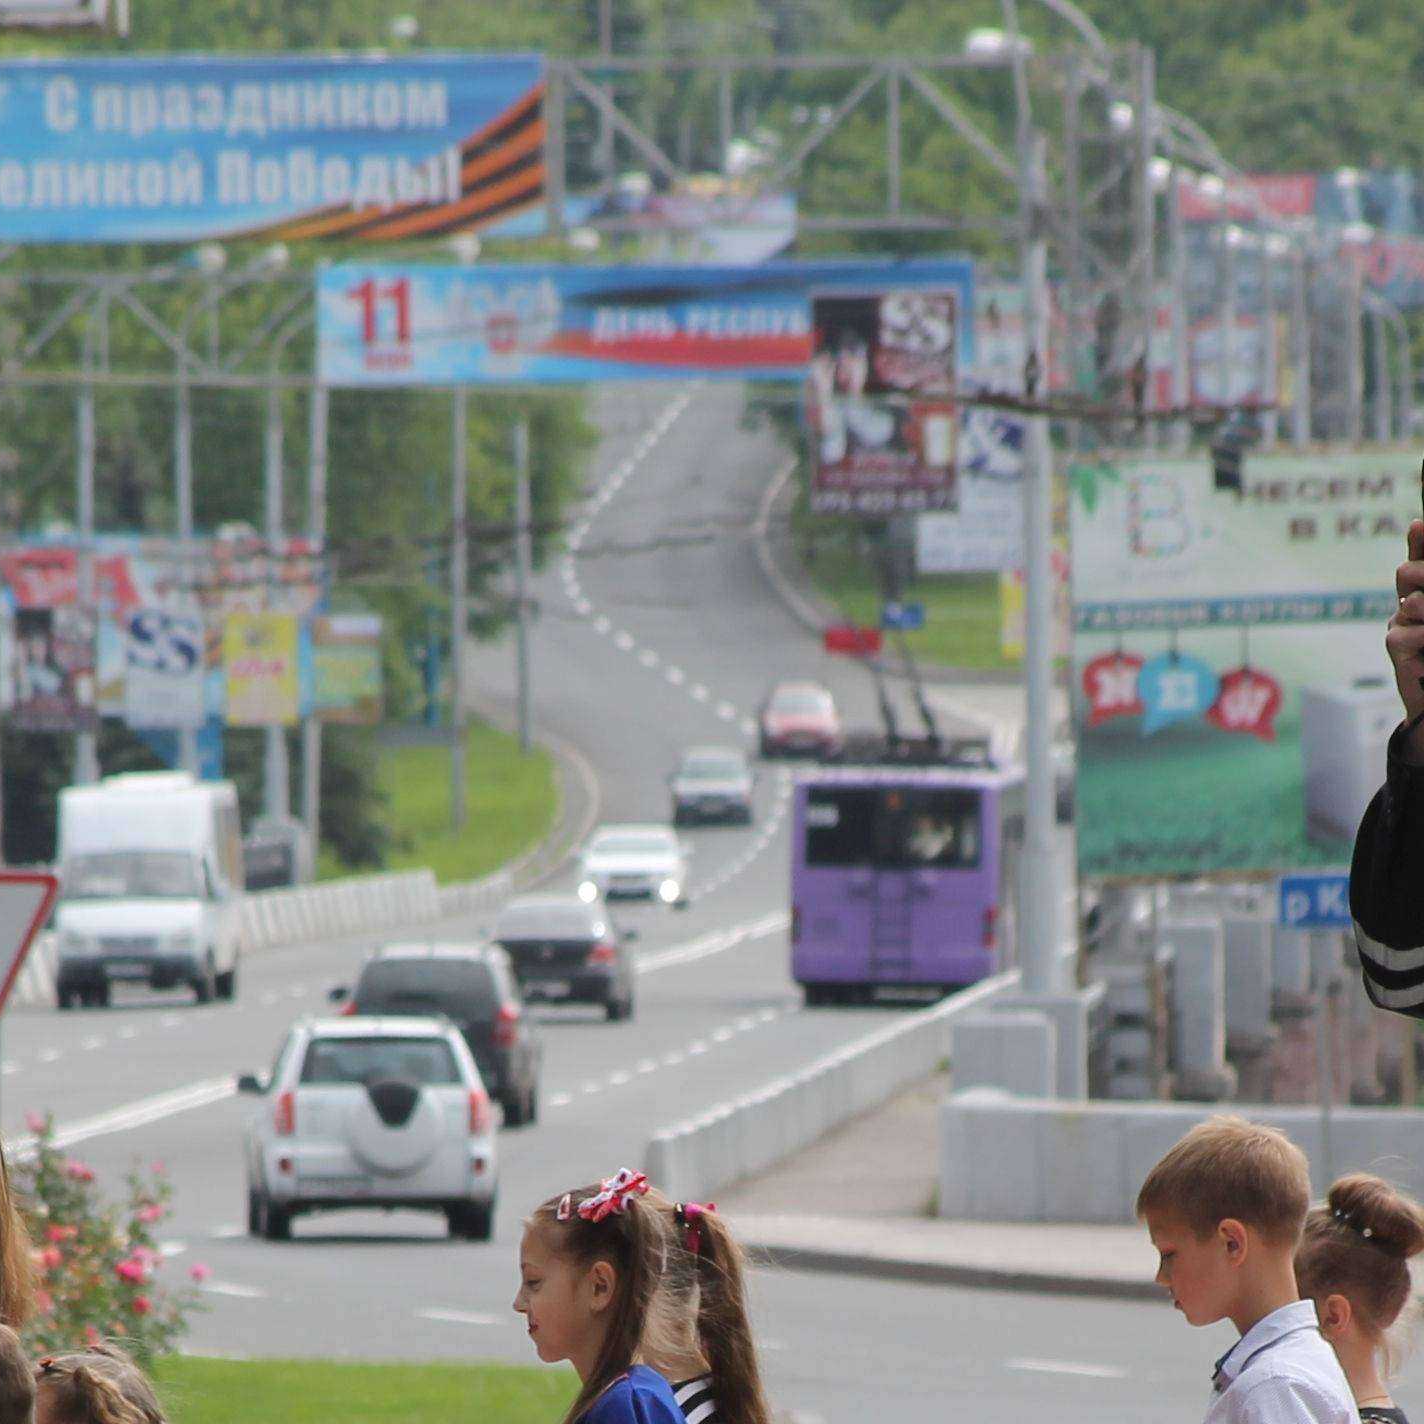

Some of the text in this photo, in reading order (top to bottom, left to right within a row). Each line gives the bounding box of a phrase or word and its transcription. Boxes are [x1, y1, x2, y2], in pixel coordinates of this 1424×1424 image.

[46, 75, 448, 137] С праздником
[216, 146, 462, 212] Победы!
[346, 277, 410, 344] 11
